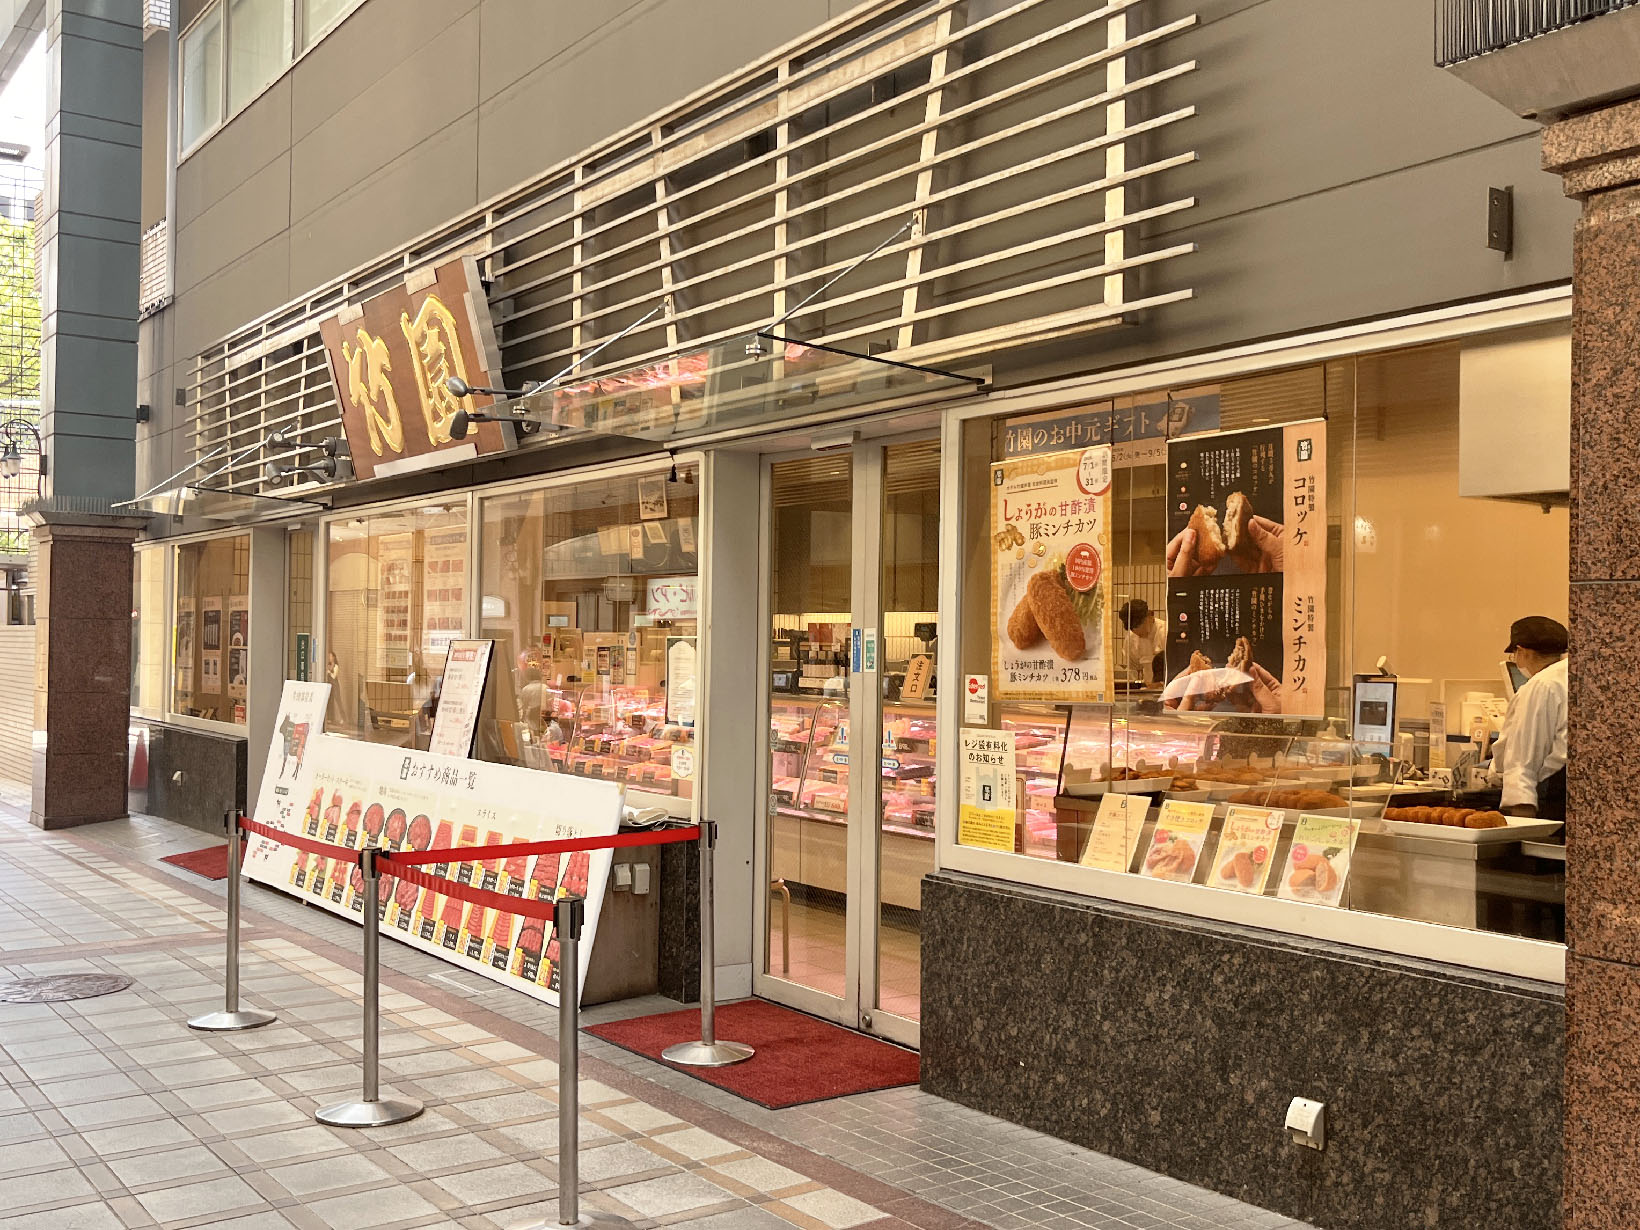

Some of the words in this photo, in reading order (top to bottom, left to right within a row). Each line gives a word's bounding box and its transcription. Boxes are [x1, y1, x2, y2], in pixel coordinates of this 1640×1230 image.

[1307, 475, 1315, 511] 竹園特製
[1004, 497, 1096, 522] しょうがの甘酢漬
[1293, 477, 1308, 546] コロッケ
[1030, 519, 1096, 540] 豚ミンチカツ
[1307, 596, 1315, 632] 竹園特製
[1293, 597, 1307, 692] ミンチカツ
[1004, 659, 1054, 670] しょうがの甘酢漬
[1010, 672, 1049, 682] 豚ミンチカツ
[965, 739, 1008, 752] レジ袋有料化
[968, 753, 1005, 764] のお知らせ
[411, 762, 477, 789] おすすめ商品一覧
